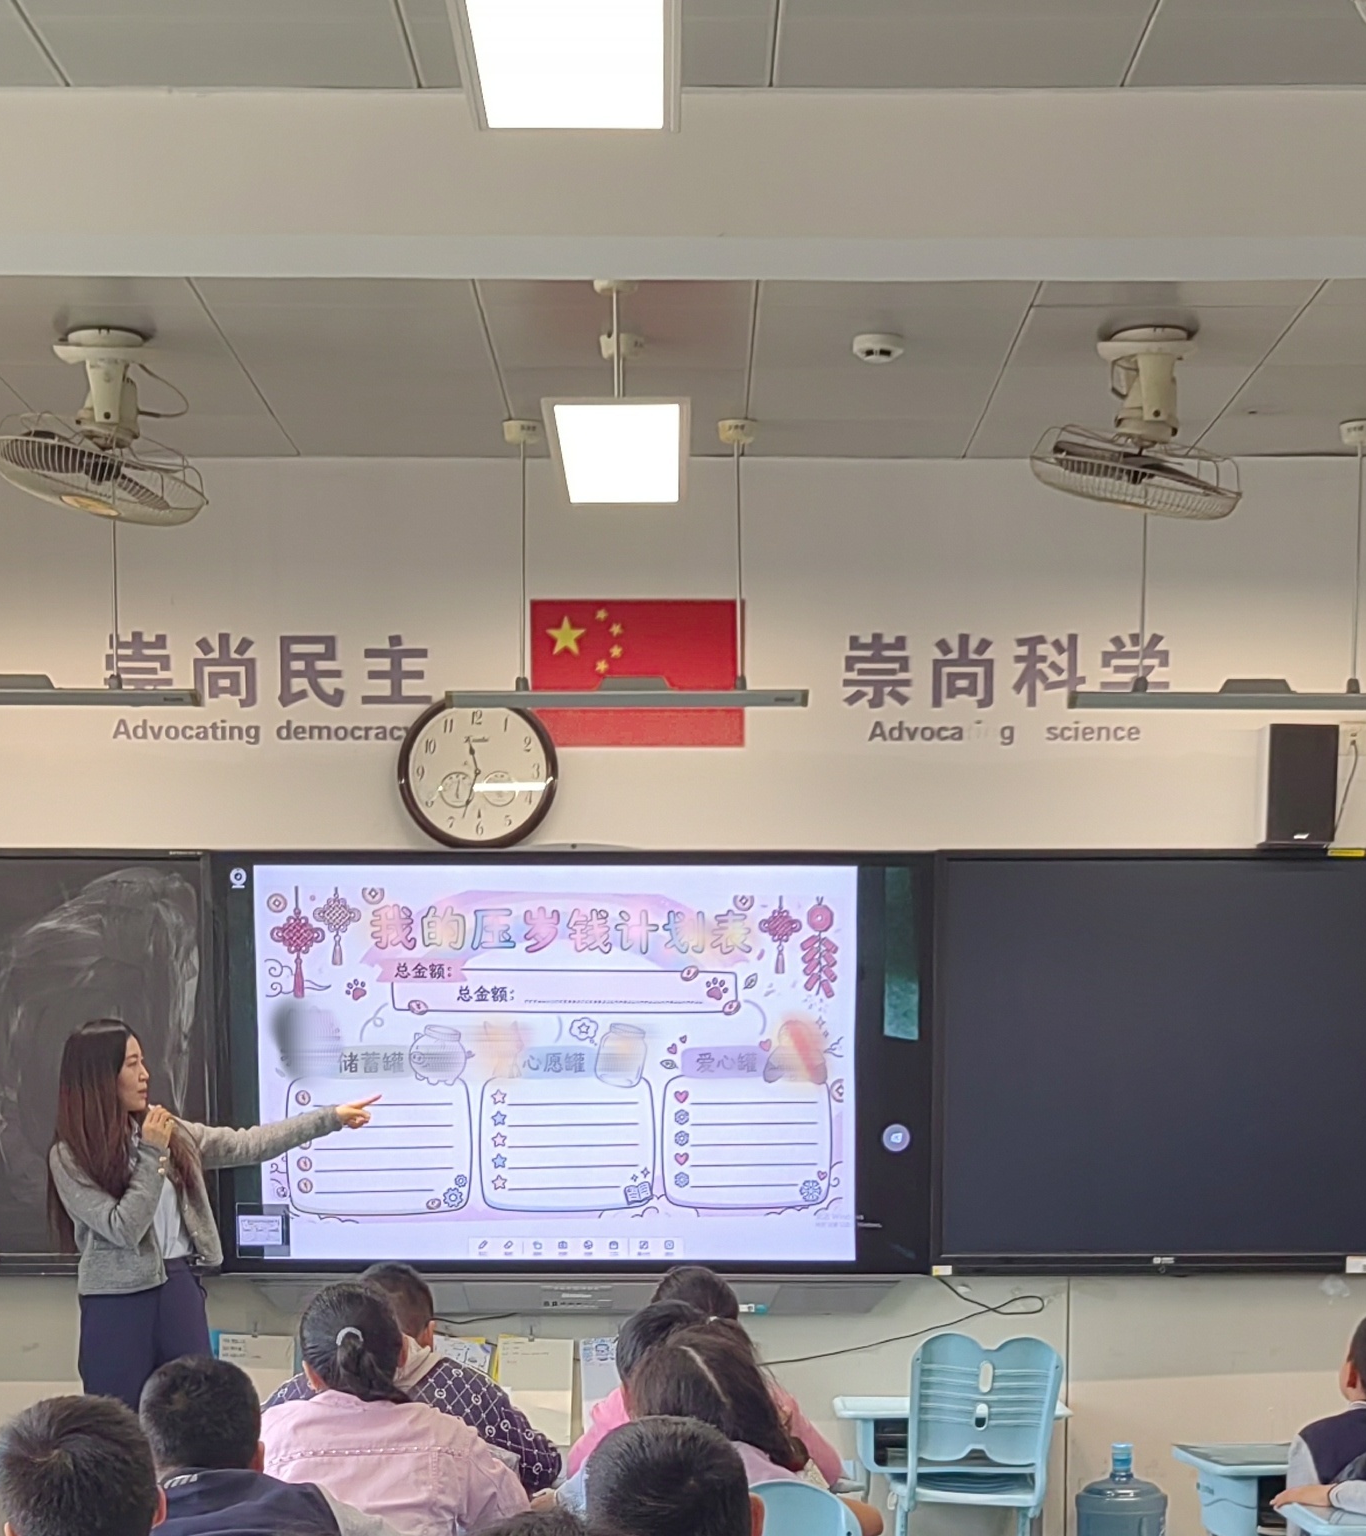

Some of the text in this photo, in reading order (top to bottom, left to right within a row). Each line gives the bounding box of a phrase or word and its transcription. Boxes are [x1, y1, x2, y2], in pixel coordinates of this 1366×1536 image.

[104, 631, 433, 708] 崇尚民主
[842, 633, 1170, 708] 崇尚科学
[443, 718, 454, 733] 11
[471, 710, 483, 725] 12
[112, 718, 261, 745] Advocating
[1046, 721, 1141, 742] science
[425, 739, 436, 754] 10
[523, 736, 532, 752] 2
[416, 765, 425, 781] 9
[532, 763, 540, 779] 3
[447, 816, 456, 828] 7
[475, 821, 484, 836] 6
[504, 815, 512, 827] 5
[370, 903, 753, 955] 我的压岁钱计划表
[393, 962, 453, 979] 总金额：
[457, 985, 515, 1003] 总金额：
[338, 1051, 405, 1074] 储蓄罐
[521, 1052, 586, 1073] 心愿罐
[695, 1052, 758, 1073] 爱心罐
